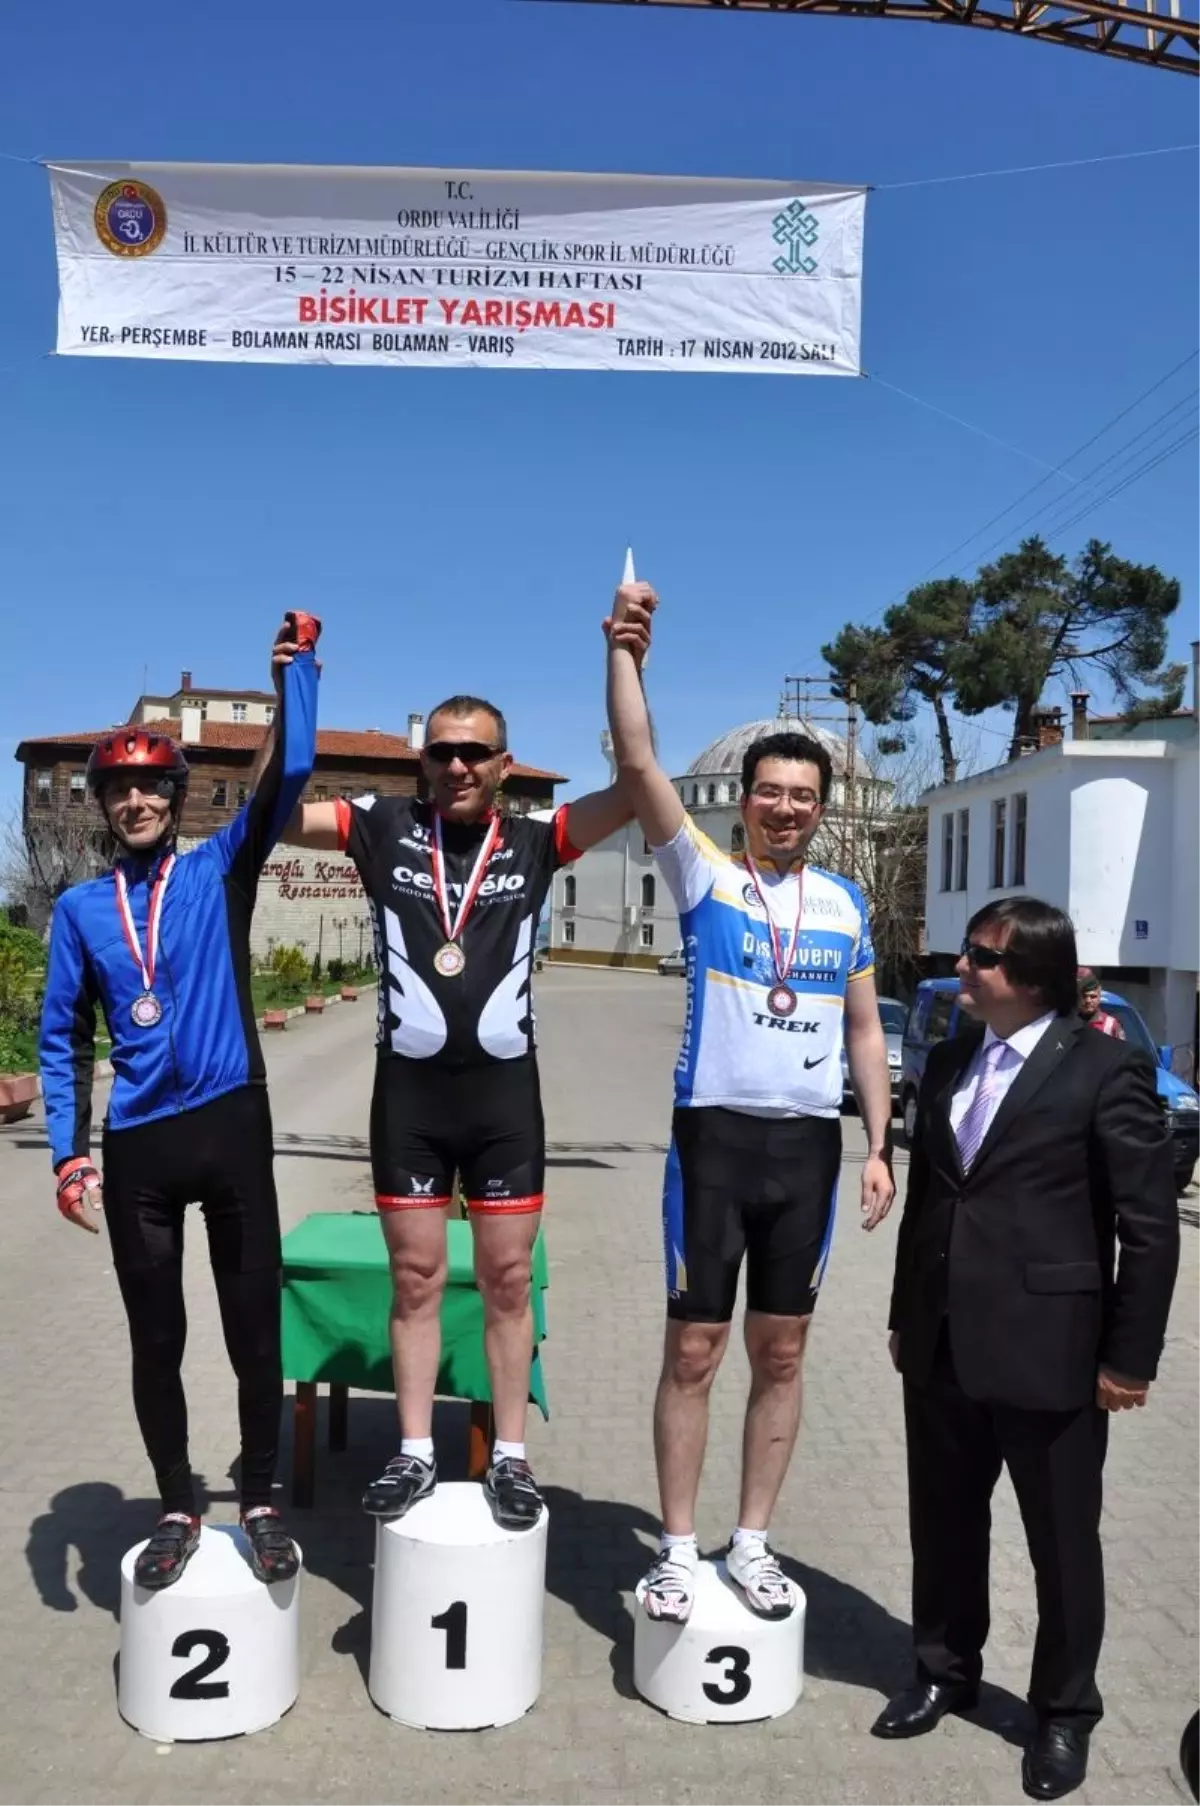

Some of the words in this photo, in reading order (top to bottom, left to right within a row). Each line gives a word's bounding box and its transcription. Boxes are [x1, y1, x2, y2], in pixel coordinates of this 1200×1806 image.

[445, 181, 473, 200] T.C.
[397, 208, 443, 229] ORDU
[448, 207, 520, 230] VALİLİĞİ
[184, 231, 200, 253] İL
[203, 232, 268, 254] KÜLTÜR
[272, 236, 293, 254] VE
[297, 233, 361, 256] TURİZM
[366, 234, 470, 258] MÜDÜRLÜĞÜ
[486, 239, 559, 262] GENÇLİK
[563, 243, 605, 261] SPOR
[610, 241, 625, 262] İL
[630, 242, 735, 266] MÜDÜRLÜĞÜ
[276, 266, 296, 282] 15
[321, 266, 344, 283] 22
[352, 263, 425, 284] NİSAN
[432, 265, 529, 287] TURİZM
[539, 270, 642, 291] HAFTASI
[299, 288, 428, 324] BİSİKLET
[439, 299, 615, 333] YARIŞMASI
[121, 326, 207, 348] PERŞEMBE
[232, 330, 308, 350] BOLAMAN
[315, 332, 360, 351] ARASI
[372, 333, 449, 352] BOLAMAN
[468, 335, 515, 356] VARIŞ
[616, 336, 663, 357] TARİH
[680, 340, 696, 357] 17
[704, 338, 754, 359] NİSAN
[760, 341, 796, 360] 2012
[278, 884, 365, 900] Restaurant
[392, 866, 525, 897] cevélo
[743, 931, 842, 969] Disovery
[752, 1012, 821, 1033] TREK
[431, 1601, 467, 1670] 1
[169, 1629, 230, 1700] 2
[702, 1645, 752, 1705] 3
